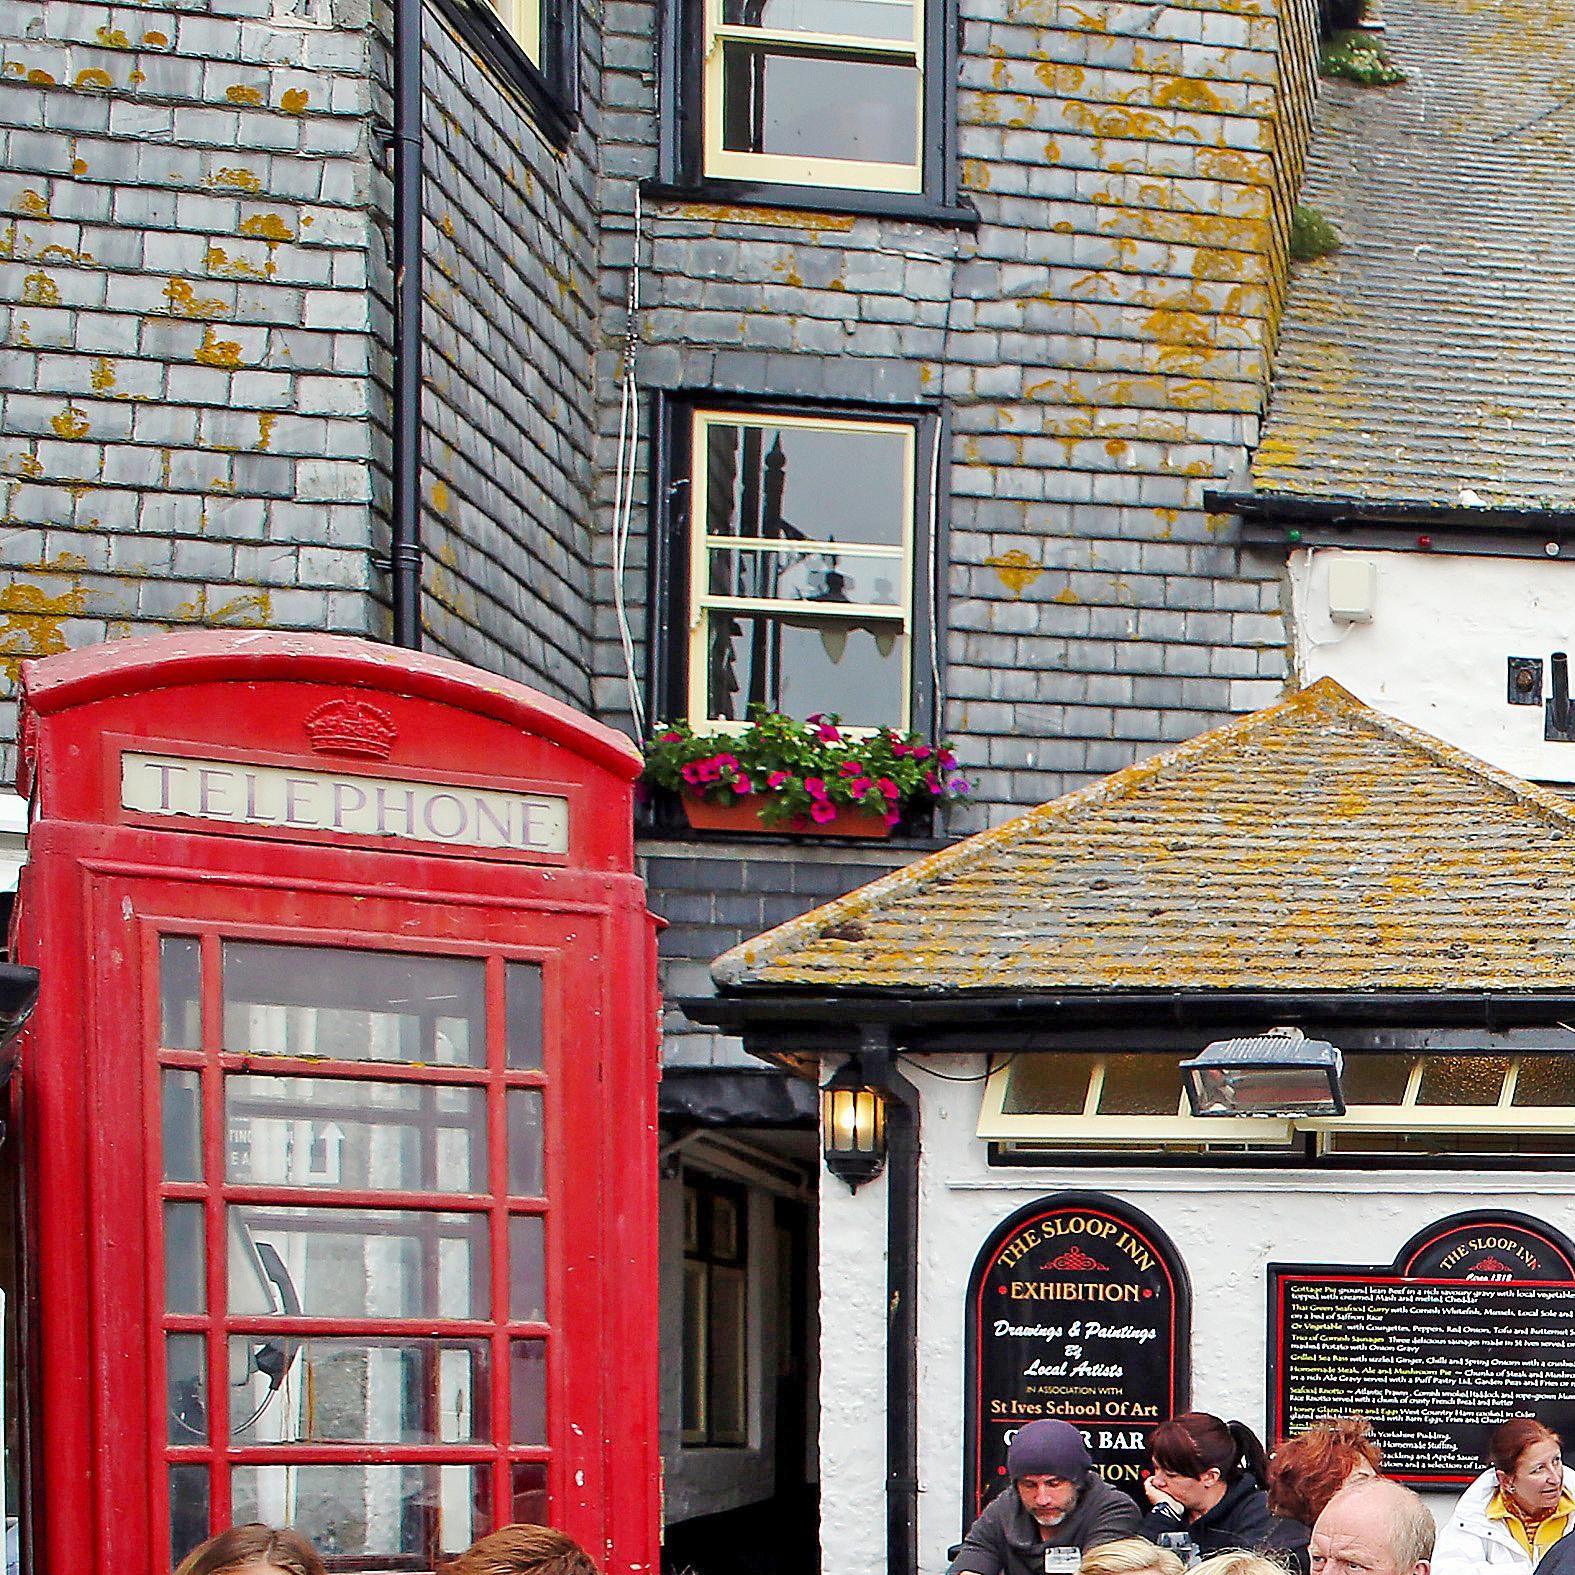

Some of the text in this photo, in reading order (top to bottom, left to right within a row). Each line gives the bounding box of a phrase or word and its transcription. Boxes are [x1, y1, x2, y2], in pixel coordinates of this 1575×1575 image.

[145, 762, 553, 847] TELEPHONE
[997, 1217, 1155, 1272] THE SLOOP INN
[1439, 1244, 1469, 1271] THE
[1470, 1237, 1517, 1257] SLOOP
[1011, 1282, 1139, 1301] EXHIBITION
[994, 1320, 1156, 1344] Drawings & Paintings
[1024, 1360, 1123, 1378] Local Artists
[1037, 1387, 1096, 1395] ASSOCIATION
[991, 1400, 1158, 1417] St Ives School Of Art
[1098, 1432, 1145, 1449] BAR
